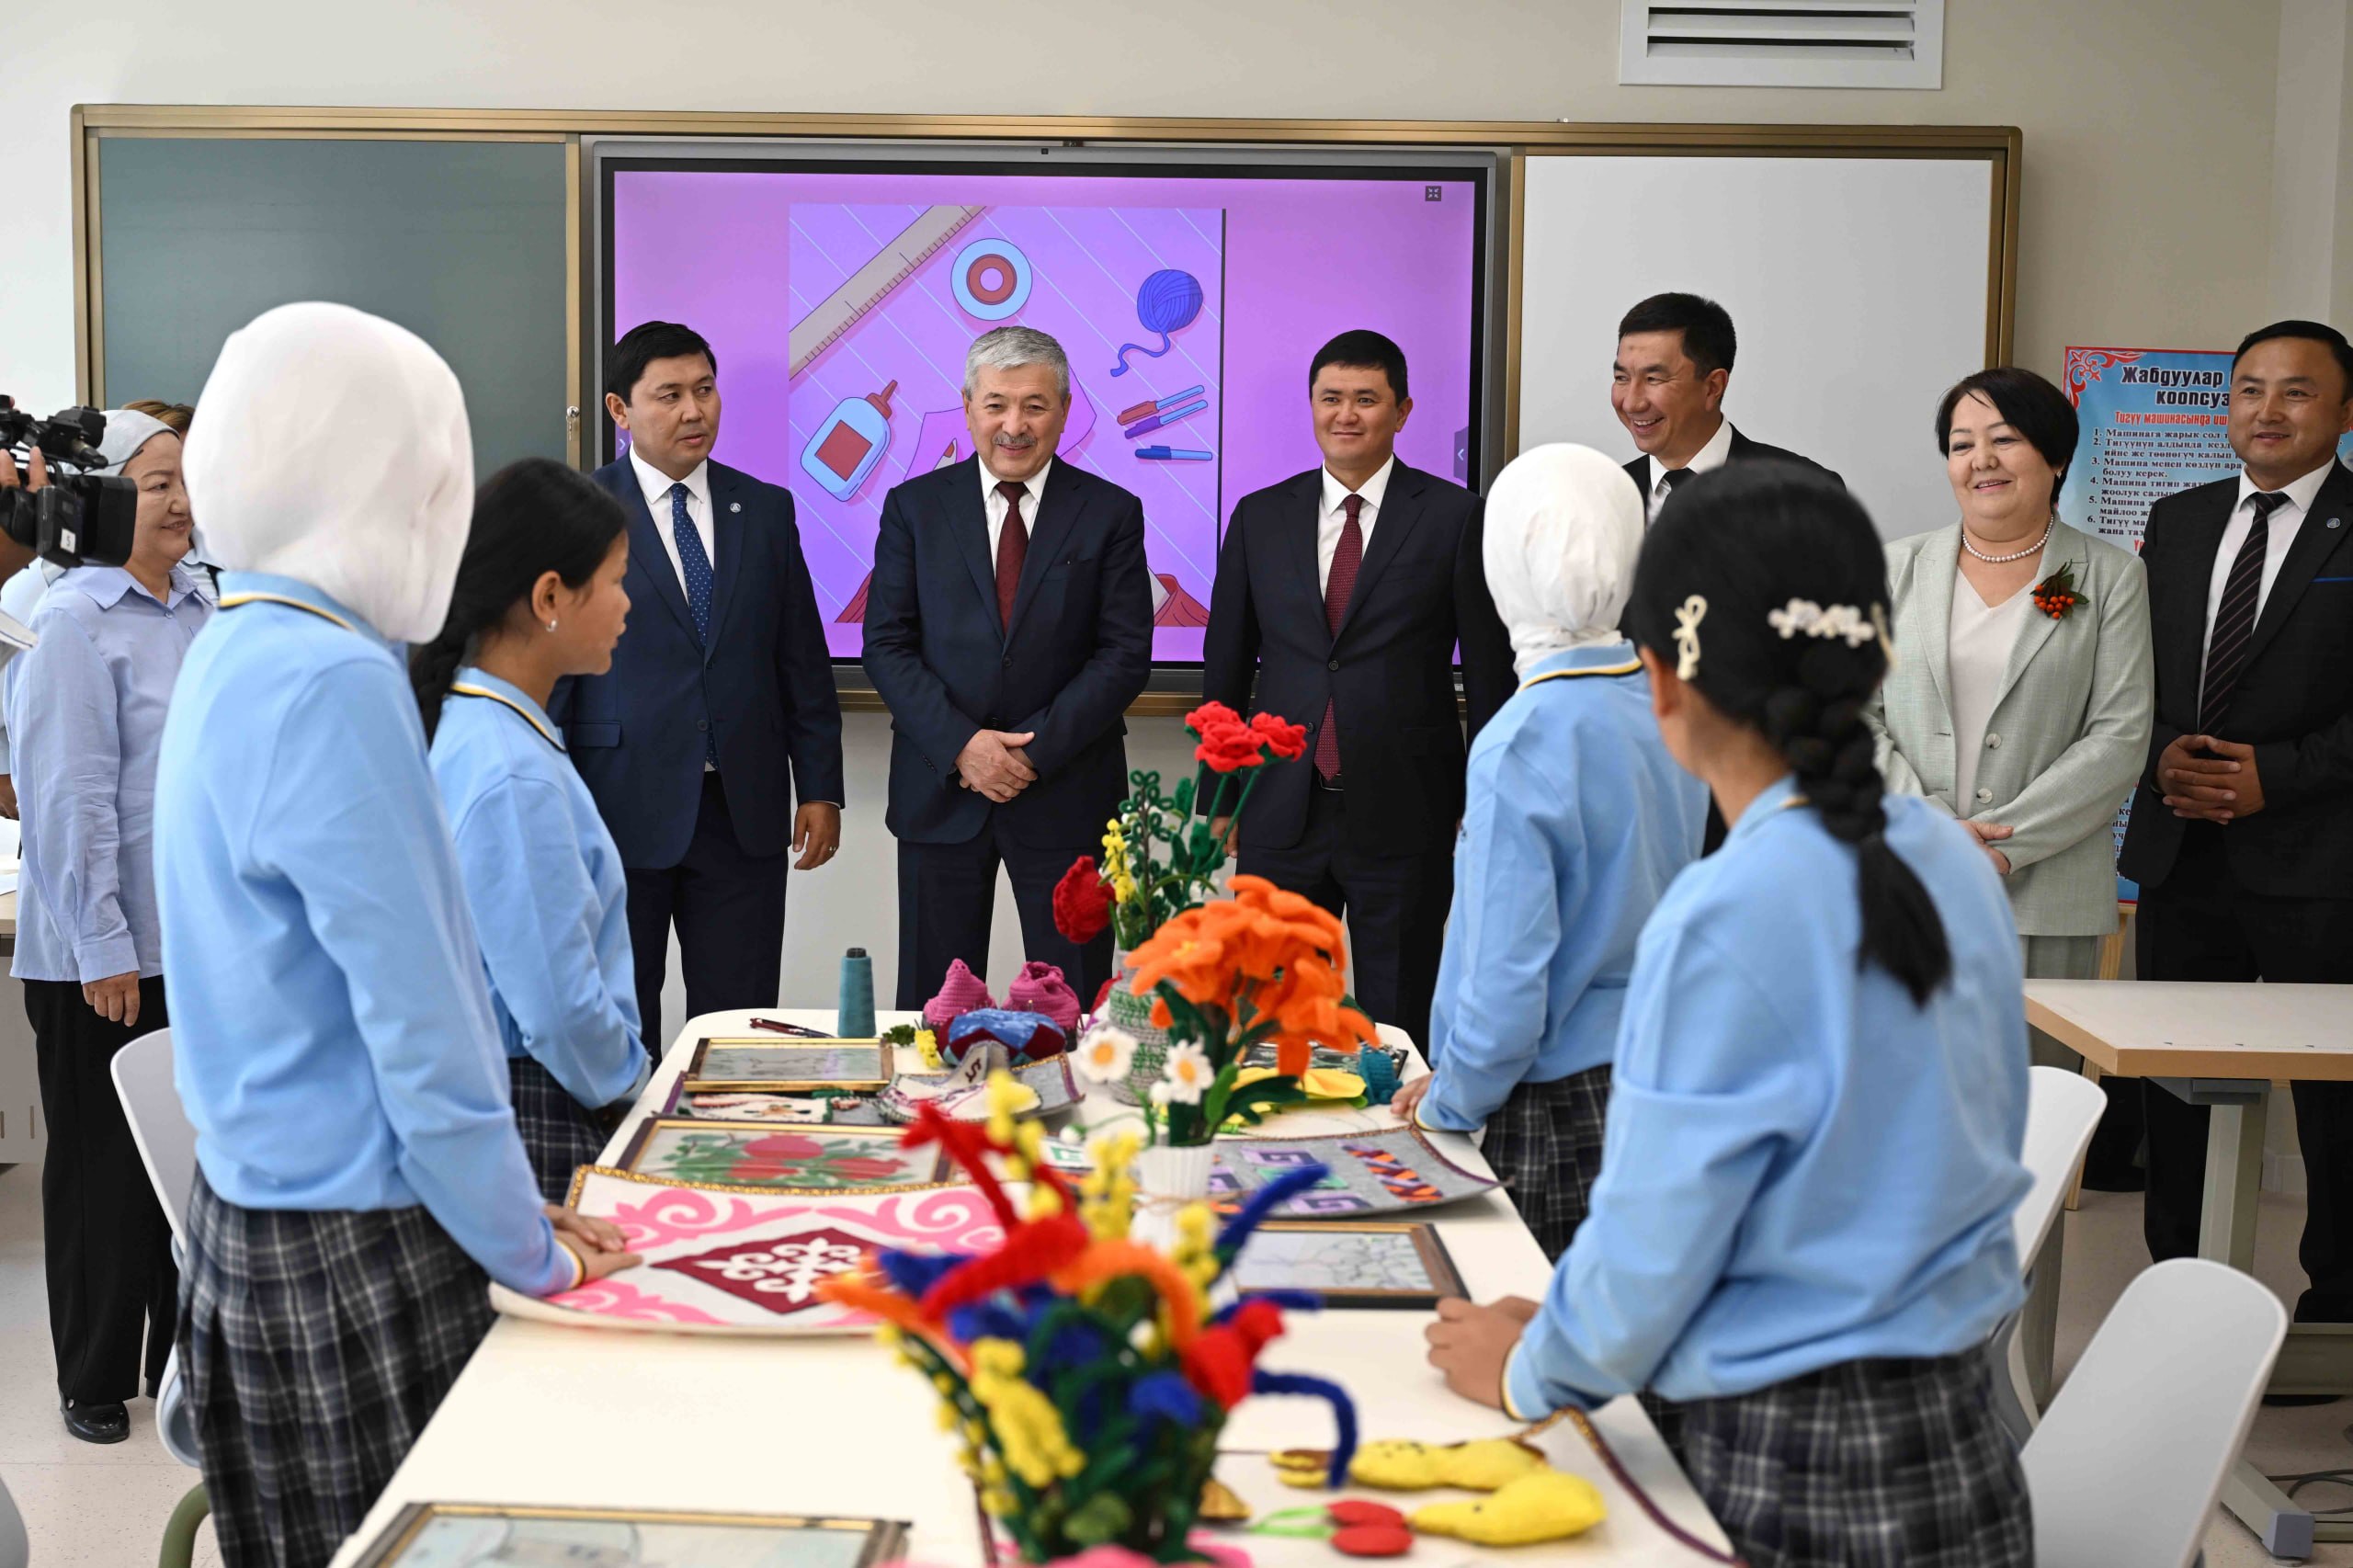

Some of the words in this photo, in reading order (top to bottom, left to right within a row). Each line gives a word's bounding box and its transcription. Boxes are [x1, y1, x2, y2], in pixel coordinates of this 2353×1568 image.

[2121, 366, 2223, 388] Жабдуулар
[2115, 411, 2141, 425] Тигүү
[2143, 413, 2211, 426] машинасында
[2106, 428, 2161, 438] Машинага
[2165, 431, 2200, 440] жарык
[2103, 458, 2148, 467] Машина
[2102, 467, 2132, 478] болуу
[2135, 471, 2168, 479] керек.
[2101, 477, 2147, 487] Машина
[2101, 489, 2141, 497] жоолук
[2100, 496, 2145, 506] Машина
[2099, 507, 2138, 516] майлоо
[2099, 516, 2130, 528] Тигүү
